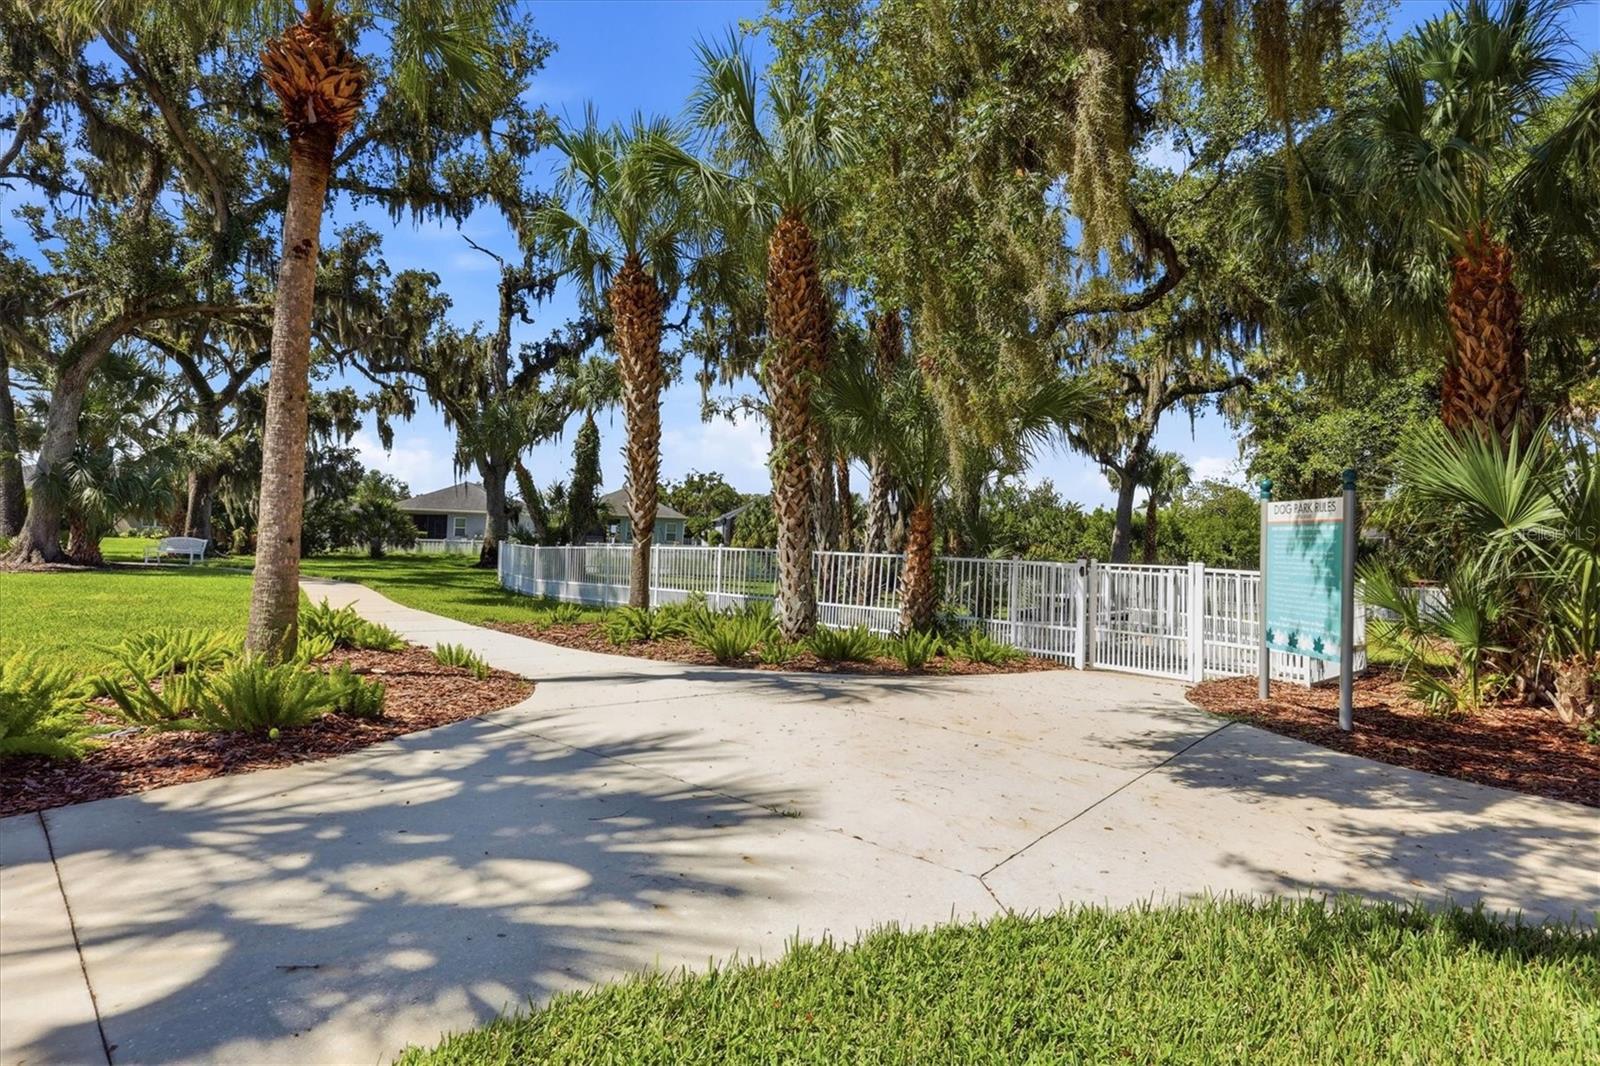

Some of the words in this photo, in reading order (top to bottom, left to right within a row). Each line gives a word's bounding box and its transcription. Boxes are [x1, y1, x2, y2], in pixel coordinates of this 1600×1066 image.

[1274, 504, 1292, 515] DOG
[1294, 502, 1313, 514] PARK
[1314, 501, 1337, 512] RULES
